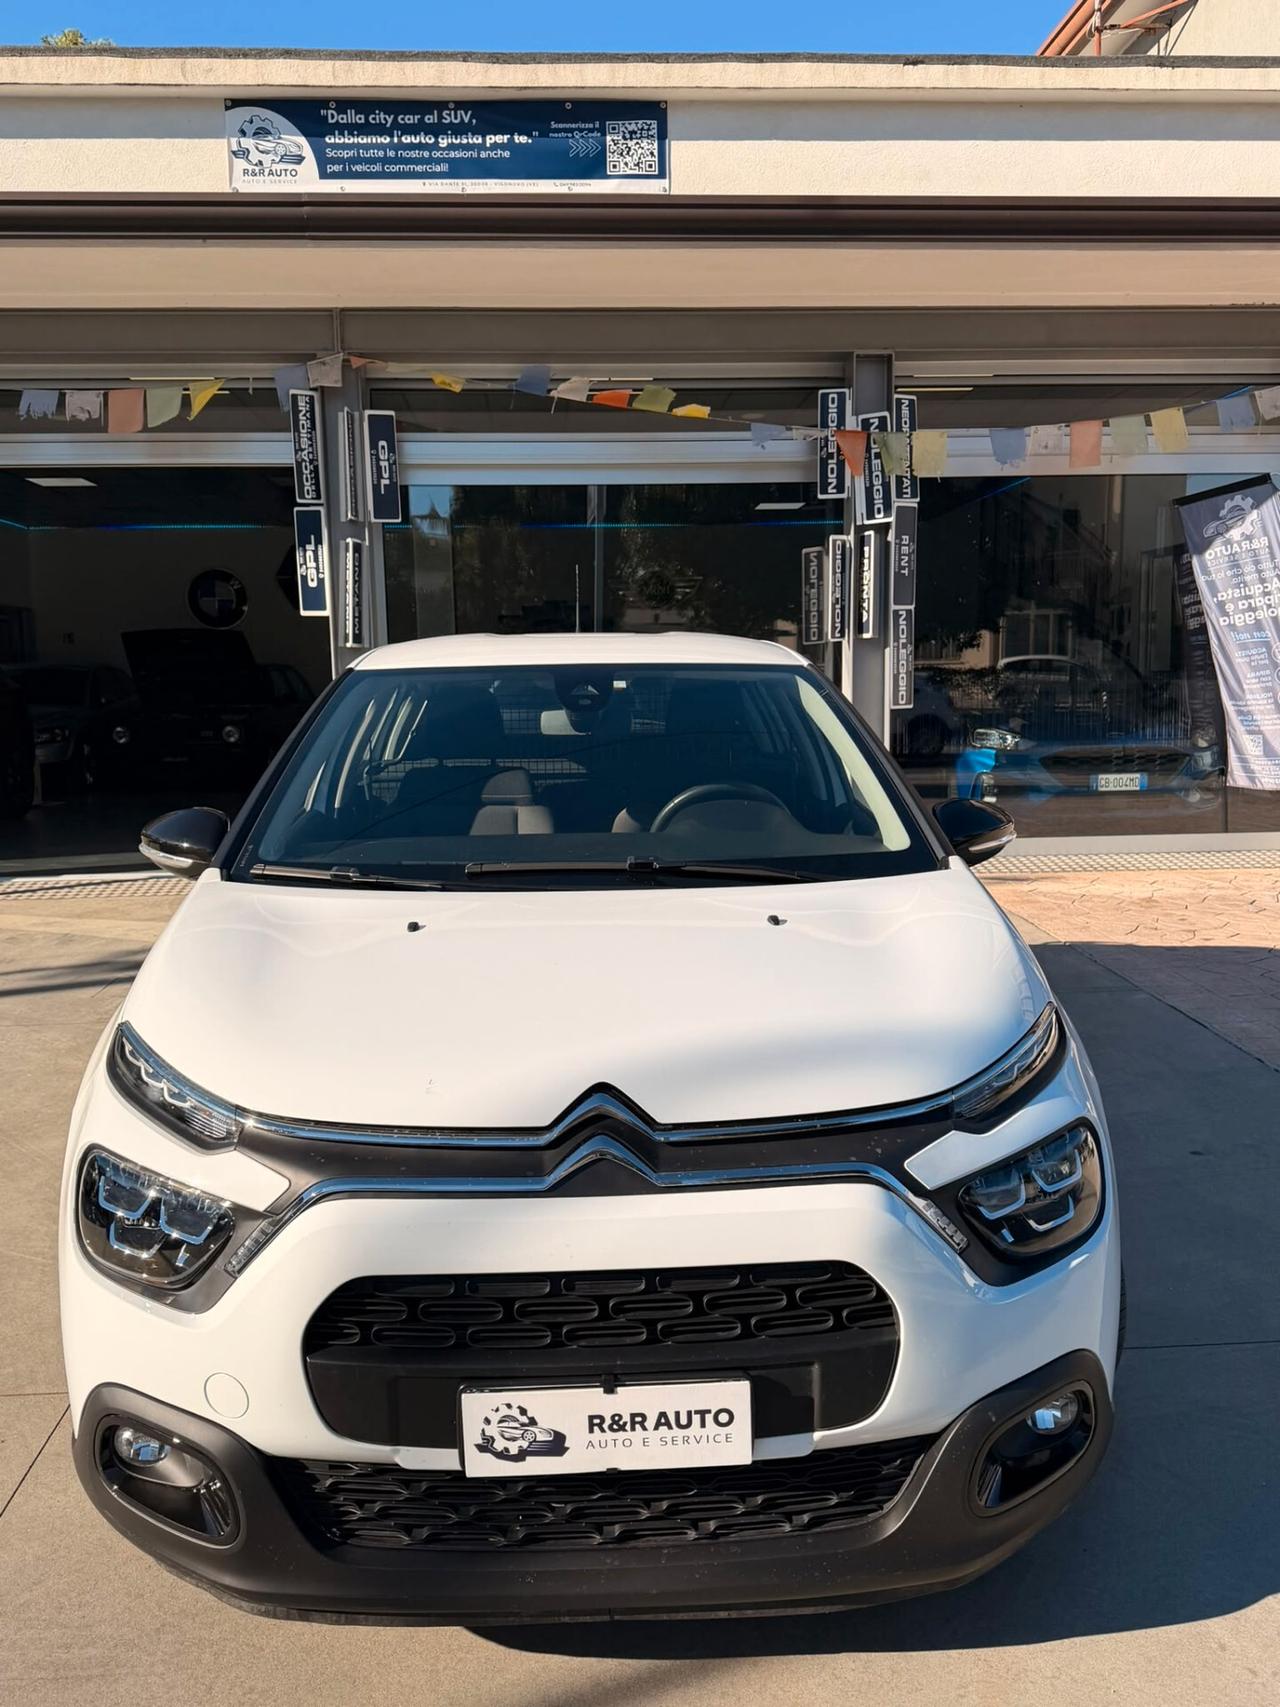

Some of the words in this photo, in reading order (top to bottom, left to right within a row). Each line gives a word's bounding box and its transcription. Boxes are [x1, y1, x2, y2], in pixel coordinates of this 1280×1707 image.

[321, 109, 365, 124] "Dalla
[368, 109, 394, 127] city
[398, 113, 421, 124] car
[424, 110, 438, 124] al
[442, 110, 477, 126] SUV,
[325, 131, 390, 144] abbiamo
[393, 131, 435, 144] l'auto
[438, 131, 482, 147] giusta
[486, 133, 511, 147] per
[514, 131, 539, 144] te."
[326, 148, 358, 161] Scopri
[360, 148, 384, 158] tutte
[386, 148, 396, 158] le
[398, 149, 430, 158] nostre
[432, 149, 478, 158] occasioni
[480, 149, 511, 158] anche
[242, 168, 266, 177] R&R
[267, 168, 298, 177] AUTO
[327, 164, 343, 174] per
[351, 162, 382, 172] veicoli
[385, 162, 449, 172] commerciali!
[298, 395, 312, 499] OCCASIONE
[827, 393, 838, 493] NOLEGGIO
[378, 440, 391, 495] GPL
[305, 534, 318, 588] GPL
[901, 535, 910, 577] RENT
[898, 610, 907, 705] NOLEGGIO
[587, 1412, 648, 1434] R&R
[653, 1408, 735, 1432] AUTO
[585, 1437, 632, 1450] AUTO
[643, 1437, 650, 1448] E
[659, 1433, 734, 1447] SERVICE
